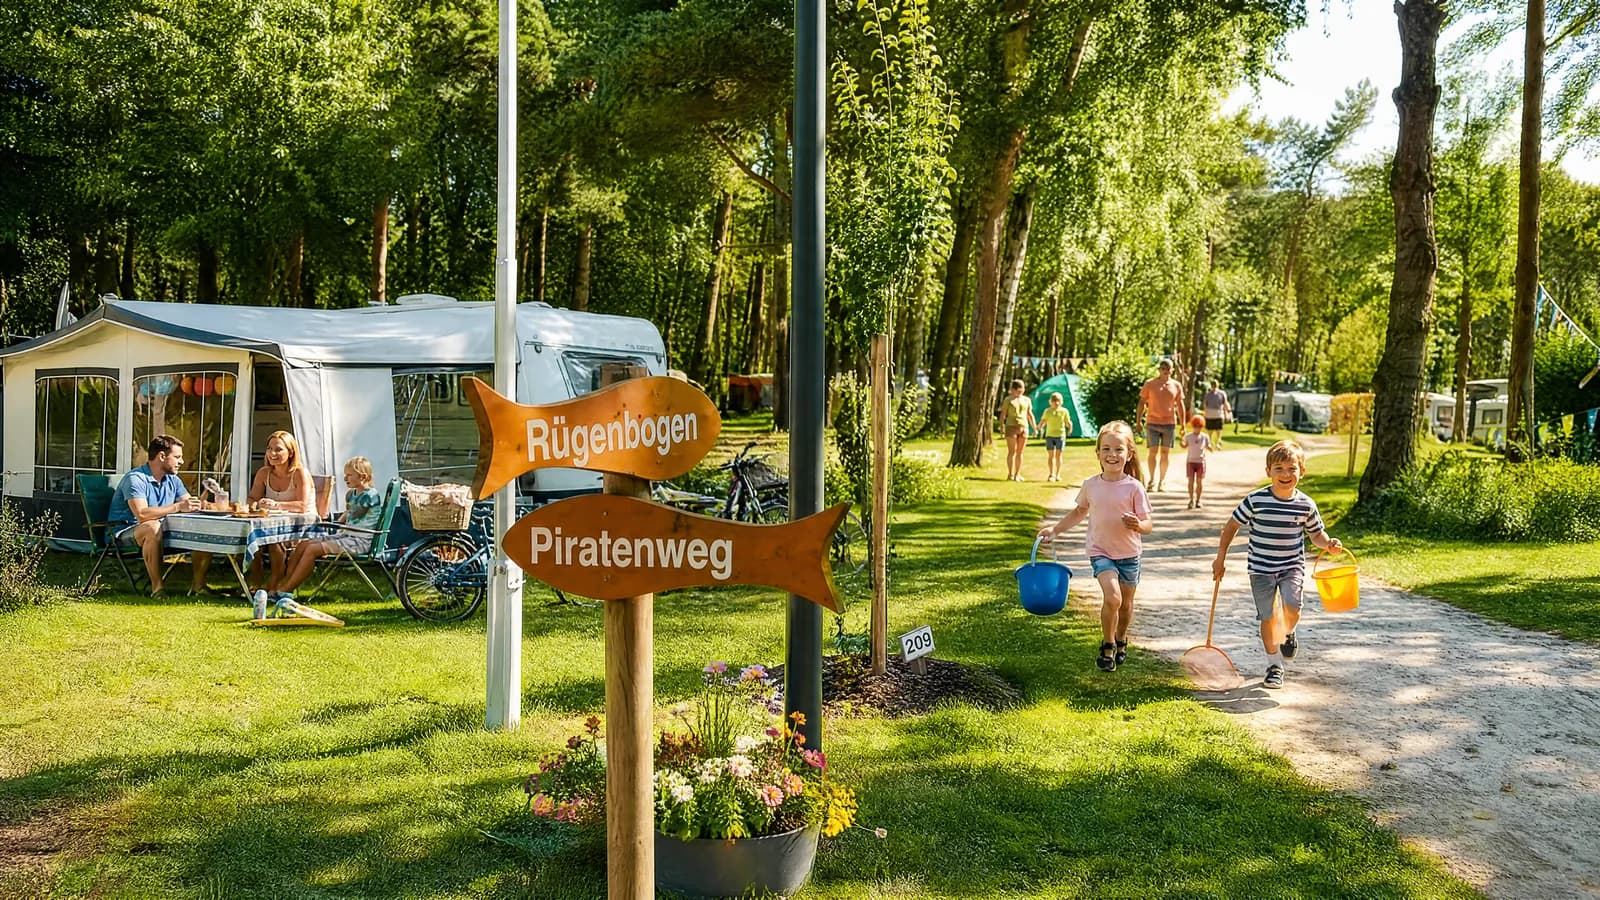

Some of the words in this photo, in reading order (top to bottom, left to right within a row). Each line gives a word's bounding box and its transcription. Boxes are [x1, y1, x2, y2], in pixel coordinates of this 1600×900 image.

[527, 412, 698, 467] Rügenbogen
[530, 526, 733, 580] Piratenweg
[905, 632, 932, 655] 209
